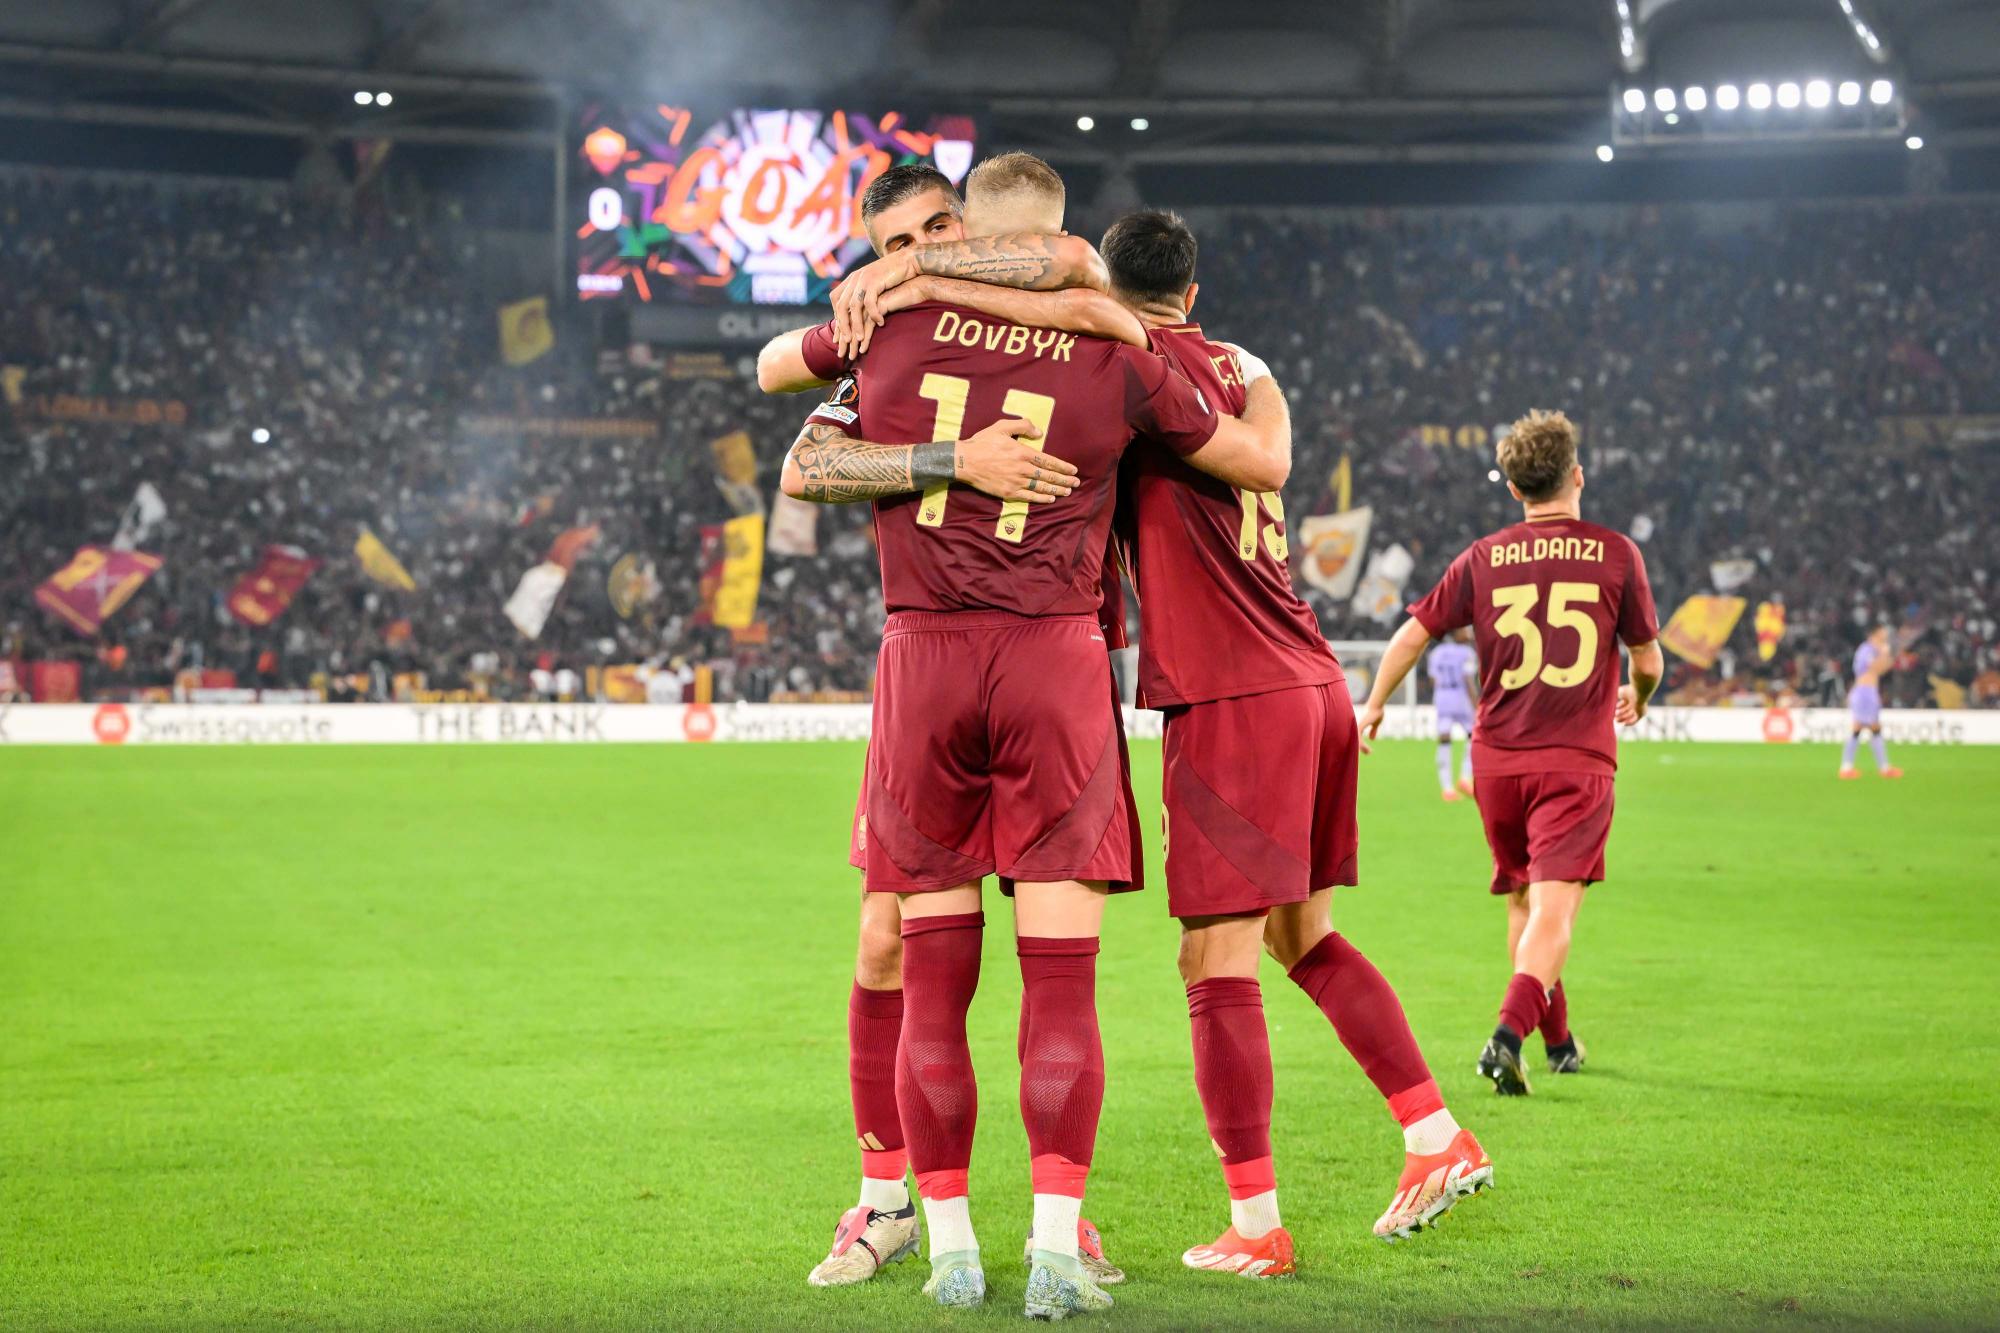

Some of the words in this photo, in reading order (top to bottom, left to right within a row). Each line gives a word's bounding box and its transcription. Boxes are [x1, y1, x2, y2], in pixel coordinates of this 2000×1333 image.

[588, 188, 623, 231] 0
[933, 311, 1078, 362] DOVBYK
[916, 372, 1056, 543] 11
[1491, 537, 1604, 567] BALDANZI
[1492, 582, 1600, 690] 35
[138, 702, 331, 742] Swissquote
[411, 703, 483, 741] THE
[500, 703, 606, 741] BANK
